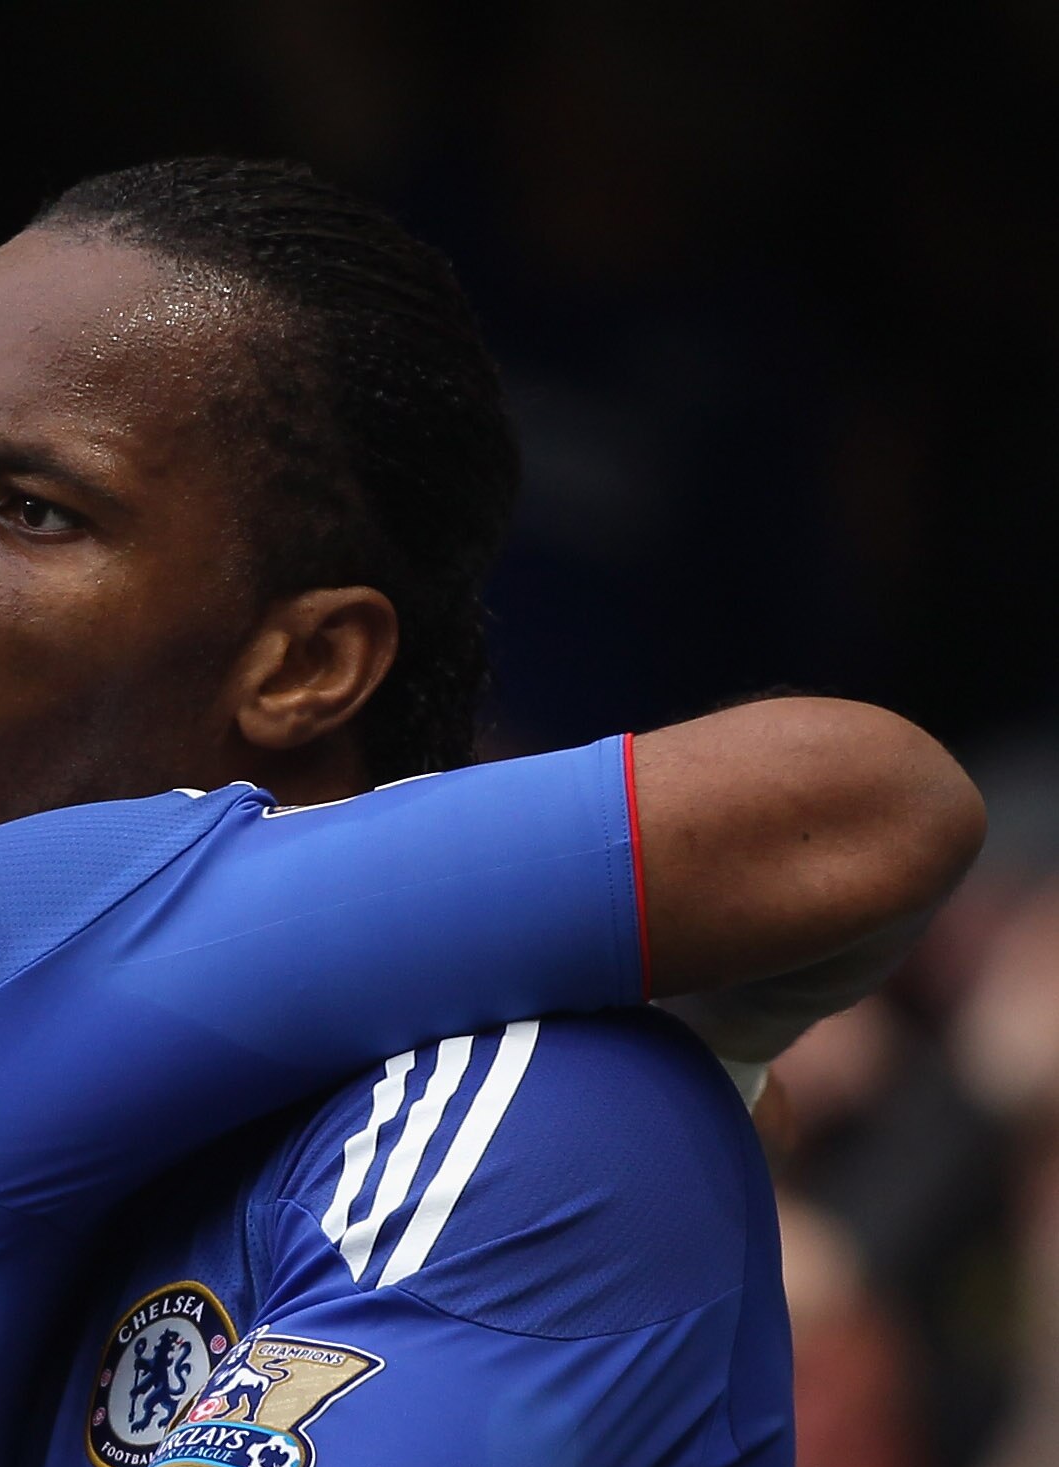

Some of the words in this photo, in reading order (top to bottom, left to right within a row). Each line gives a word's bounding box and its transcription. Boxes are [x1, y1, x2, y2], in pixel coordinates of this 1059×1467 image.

[118, 1295, 205, 1343] CHELSEA
[258, 1344, 344, 1365] CHAMPIONS
[176, 1445, 236, 1463] LEAGUE
